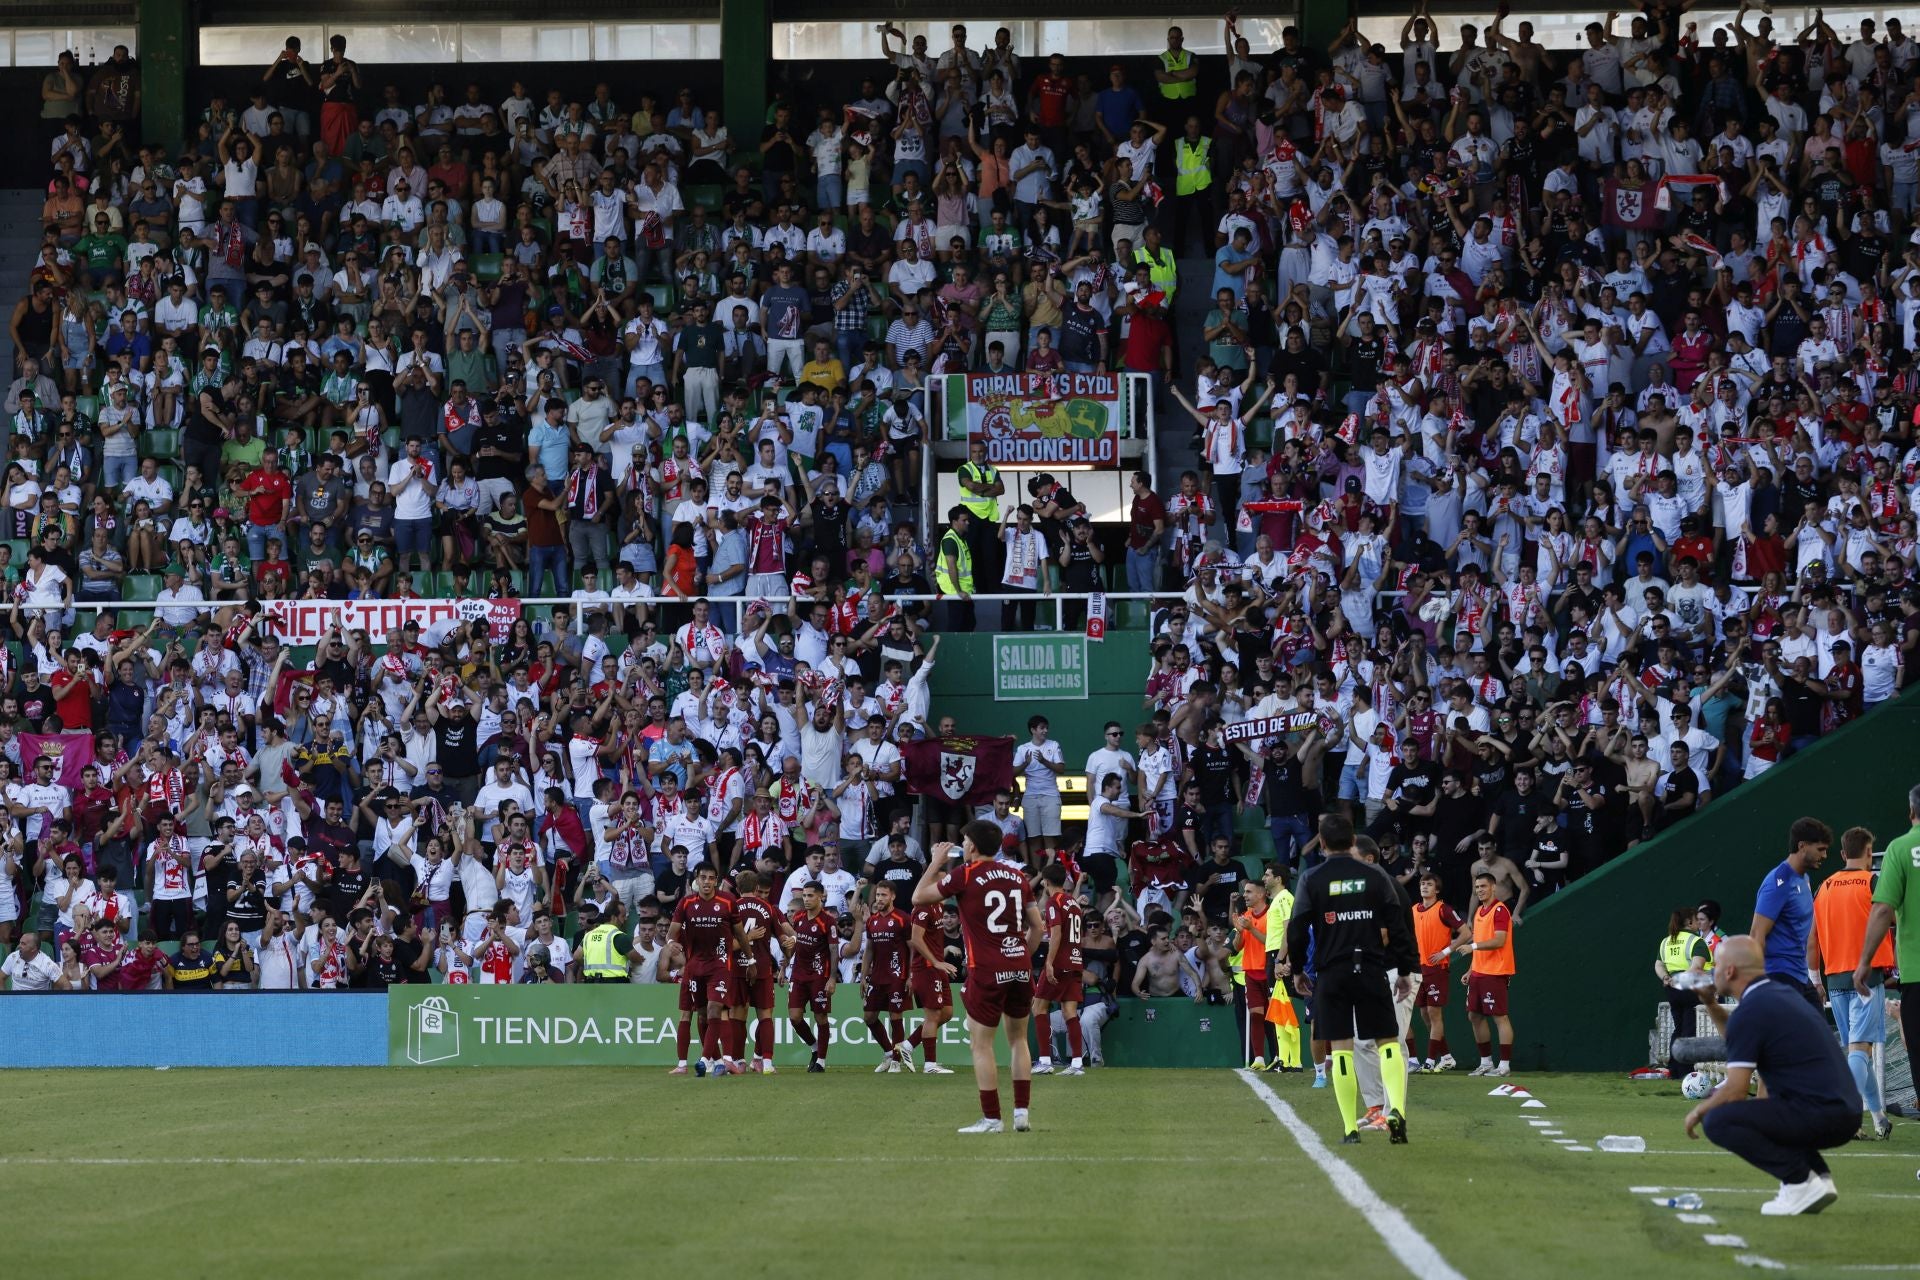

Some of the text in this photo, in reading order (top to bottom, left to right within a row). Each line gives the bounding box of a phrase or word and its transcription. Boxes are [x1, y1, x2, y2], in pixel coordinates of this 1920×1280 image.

[972, 375, 1025, 397] RURAL
[1074, 373, 1115, 395] CYDL
[462, 601, 485, 611] NICO
[498, 624, 510, 633] LA
[1000, 644, 1081, 671] SALIDA DE
[1000, 673, 1082, 690] EMERGENCIAS
[1225, 720, 1267, 741] ESTILO
[1269, 716, 1286, 733] DE
[1289, 711, 1318, 727] VIDA
[1329, 878, 1365, 896] BKT
[1833, 878, 1868, 888] macron
[747, 902, 770, 919] SUÁREZ
[984, 889, 1023, 934] 21
[1336, 910, 1373, 922] WÜRTH
[743, 917, 757, 946] 4
[1068, 914, 1081, 944] 19
